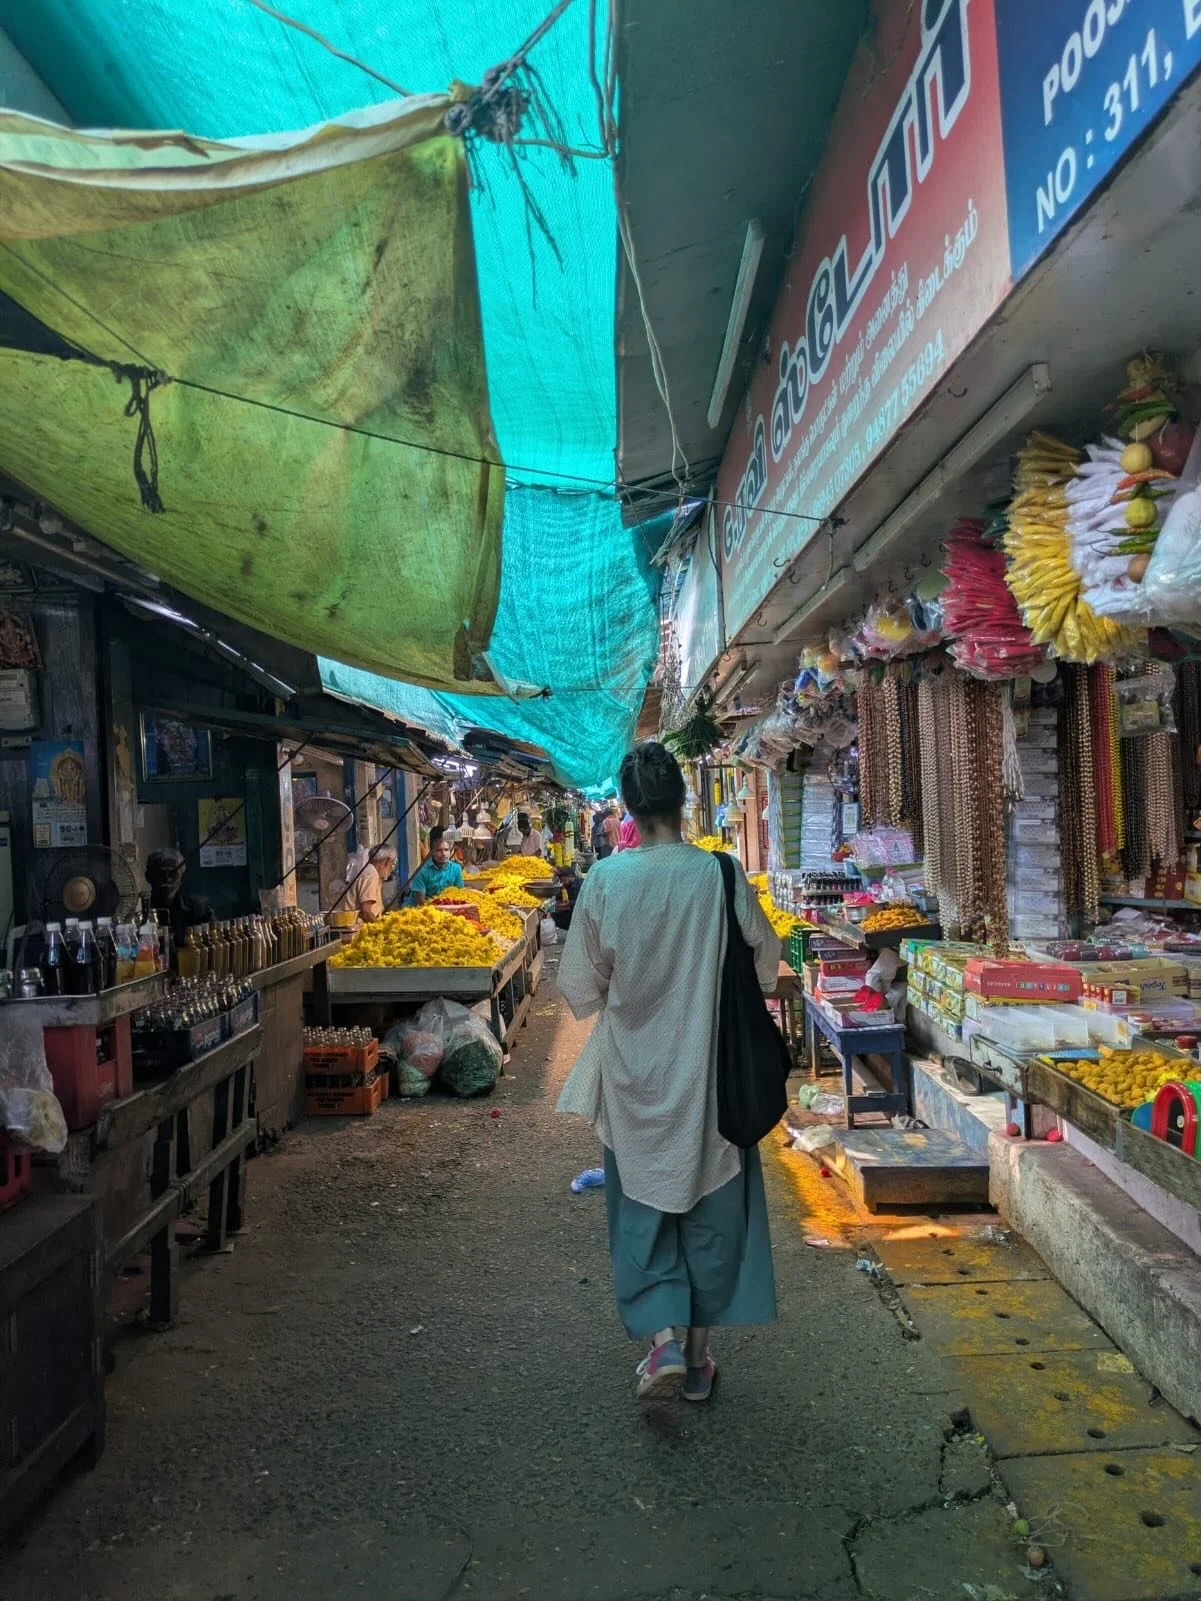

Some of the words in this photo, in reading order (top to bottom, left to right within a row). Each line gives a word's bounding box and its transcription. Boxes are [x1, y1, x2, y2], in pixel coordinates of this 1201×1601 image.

[1036, 146, 1077, 234] NO
[1103, 27, 1173, 142] 311,
[839, 330, 865, 394] மற்றும்
[865, 260, 908, 350] அனைத்து
[872, 297, 915, 389] விலையில்
[915, 197, 978, 320] கிடைக்கும்
[865, 388, 899, 453] 94877
[901, 327, 945, 407] 55694
